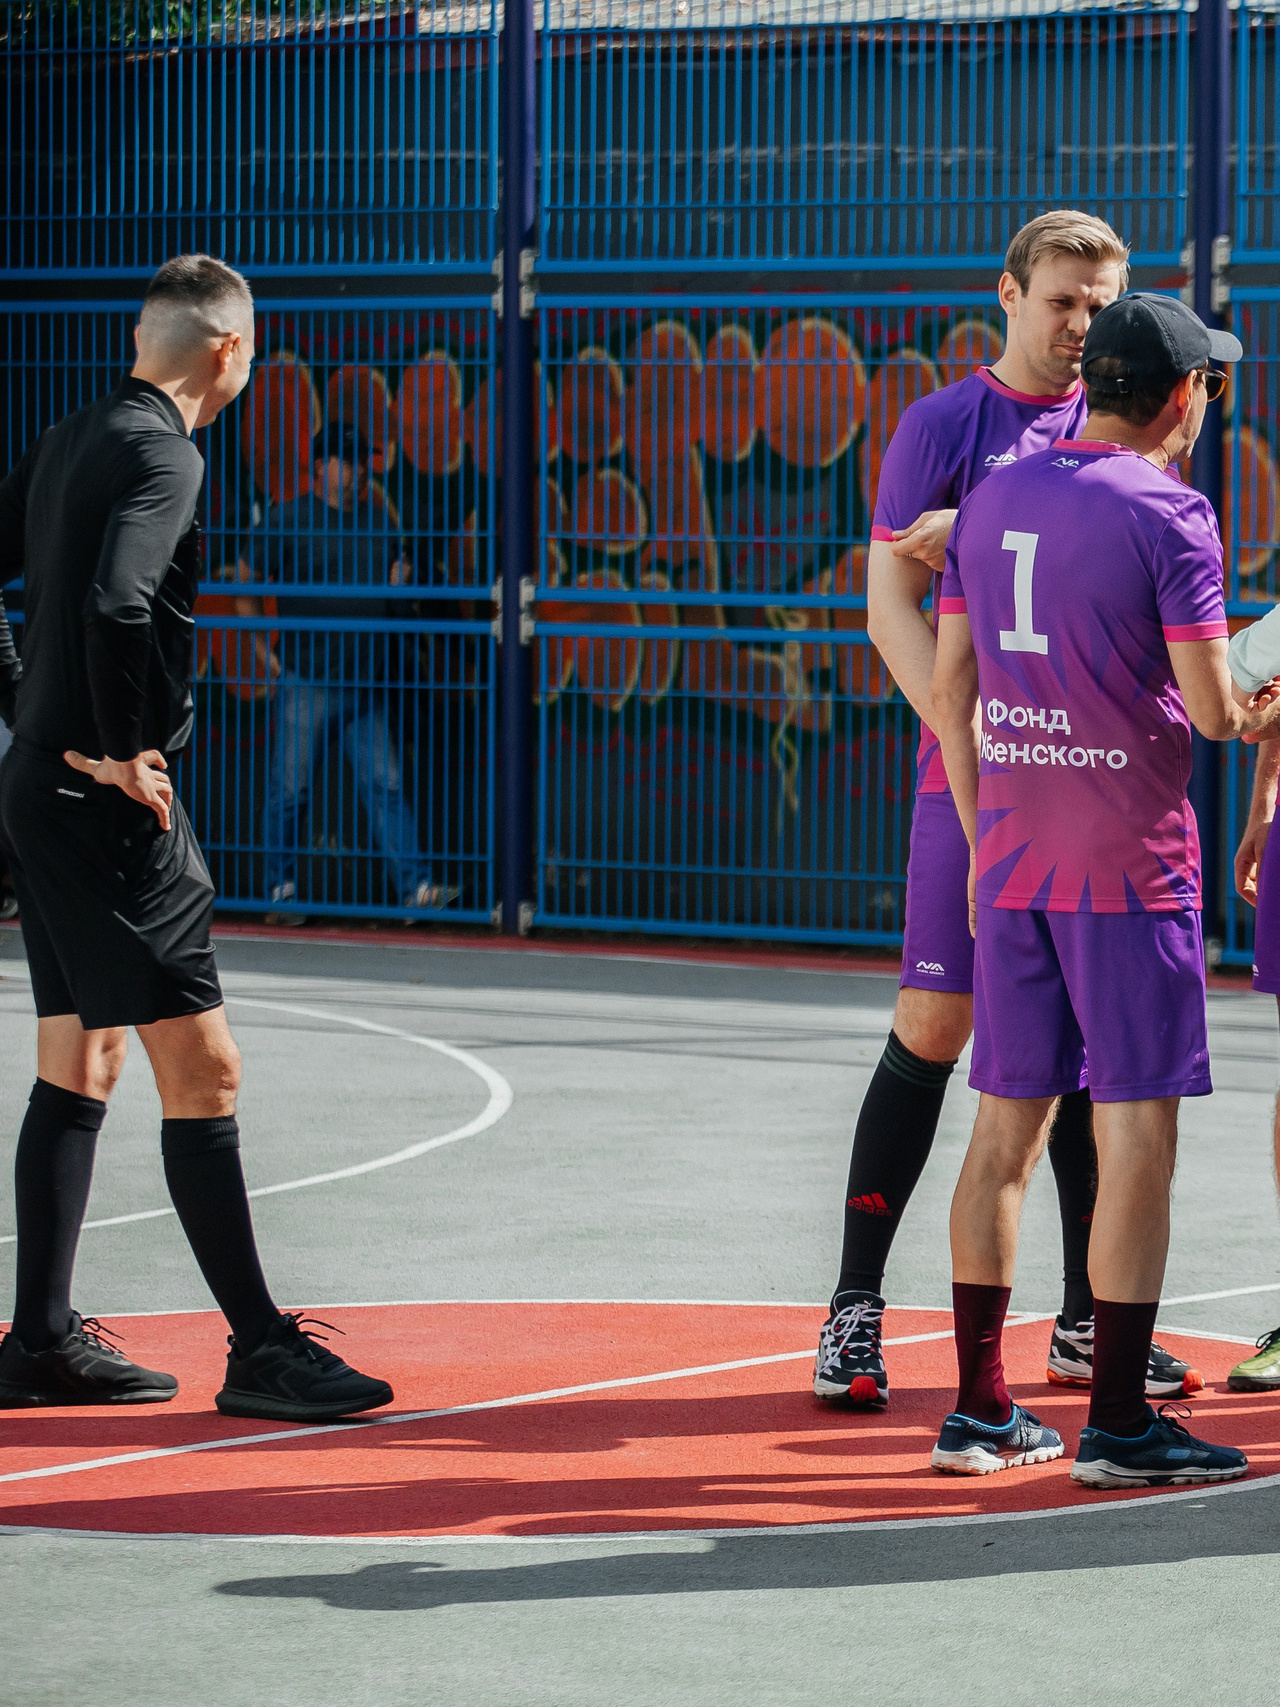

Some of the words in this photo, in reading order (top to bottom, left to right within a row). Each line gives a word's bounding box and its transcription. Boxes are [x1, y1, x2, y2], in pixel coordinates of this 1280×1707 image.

[999, 529, 1048, 656] 1
[986, 698, 1072, 736] Фонд
[980, 730, 1129, 770] Хбенского
